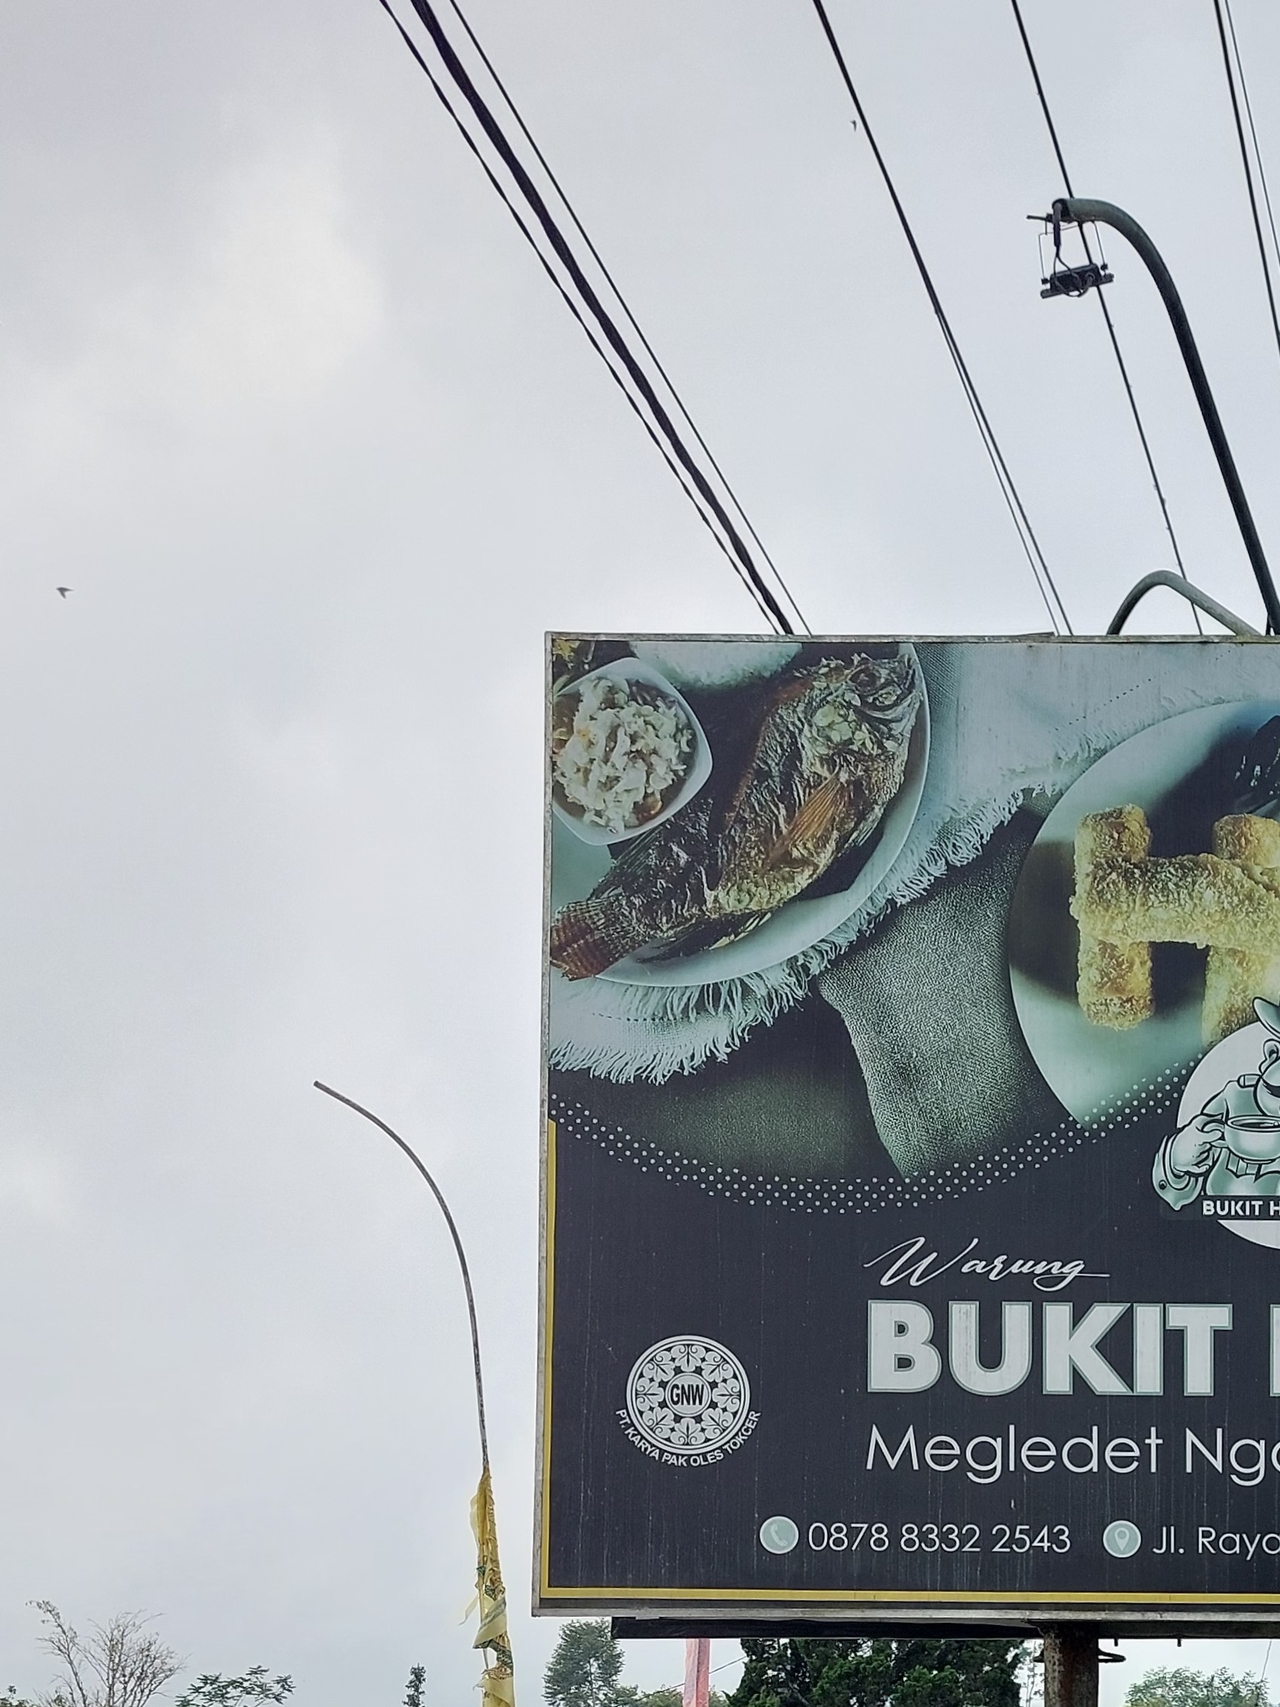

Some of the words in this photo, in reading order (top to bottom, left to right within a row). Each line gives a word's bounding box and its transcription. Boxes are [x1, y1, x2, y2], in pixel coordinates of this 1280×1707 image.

[1202, 1200, 1264, 1217] BUKIT
[864, 1237, 1110, 1291] Warung
[867, 1299, 1233, 1397] BUKIT
[669, 1382, 706, 1407] GNW
[615, 1408, 631, 1429] PT.
[624, 1426, 660, 1461] KARYA
[661, 1454, 688, 1467] PAK
[689, 1449, 724, 1467] OLES
[725, 1410, 762, 1455] TOKCER
[866, 1424, 1163, 1484] Megledet
[808, 1522, 889, 1552] 0878
[900, 1523, 981, 1552] 8332
[991, 1524, 1071, 1553] 2543
[1152, 1525, 1185, 1554] Jl.
